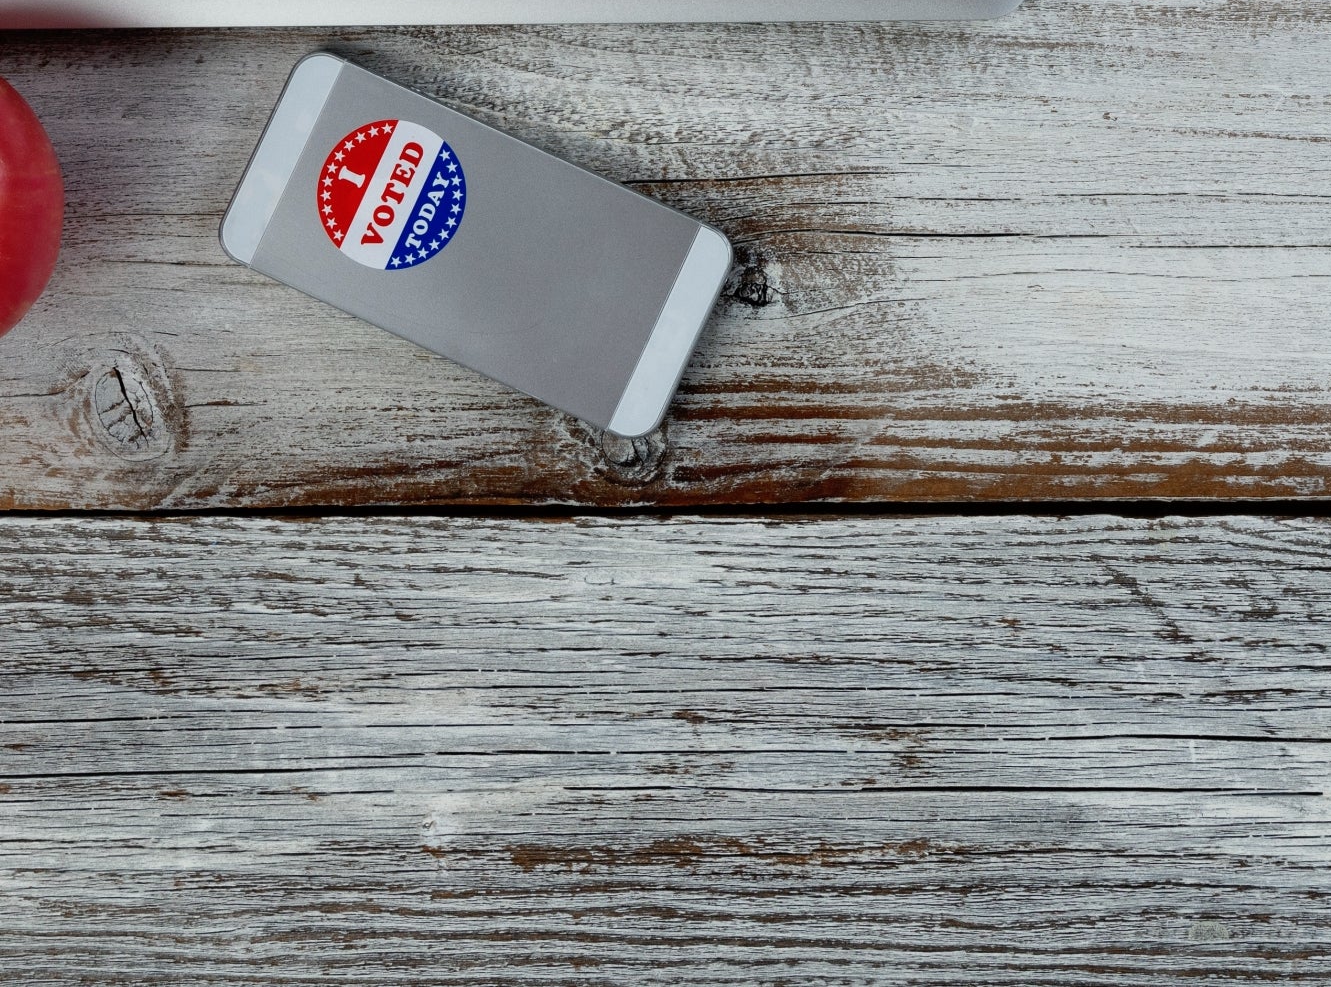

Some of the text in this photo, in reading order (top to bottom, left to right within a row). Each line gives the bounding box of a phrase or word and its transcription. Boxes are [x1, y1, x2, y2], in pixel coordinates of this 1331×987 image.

[338, 166, 366, 188] I
[361, 141, 424, 245] VOTED
[405, 171, 450, 248] TODAY
